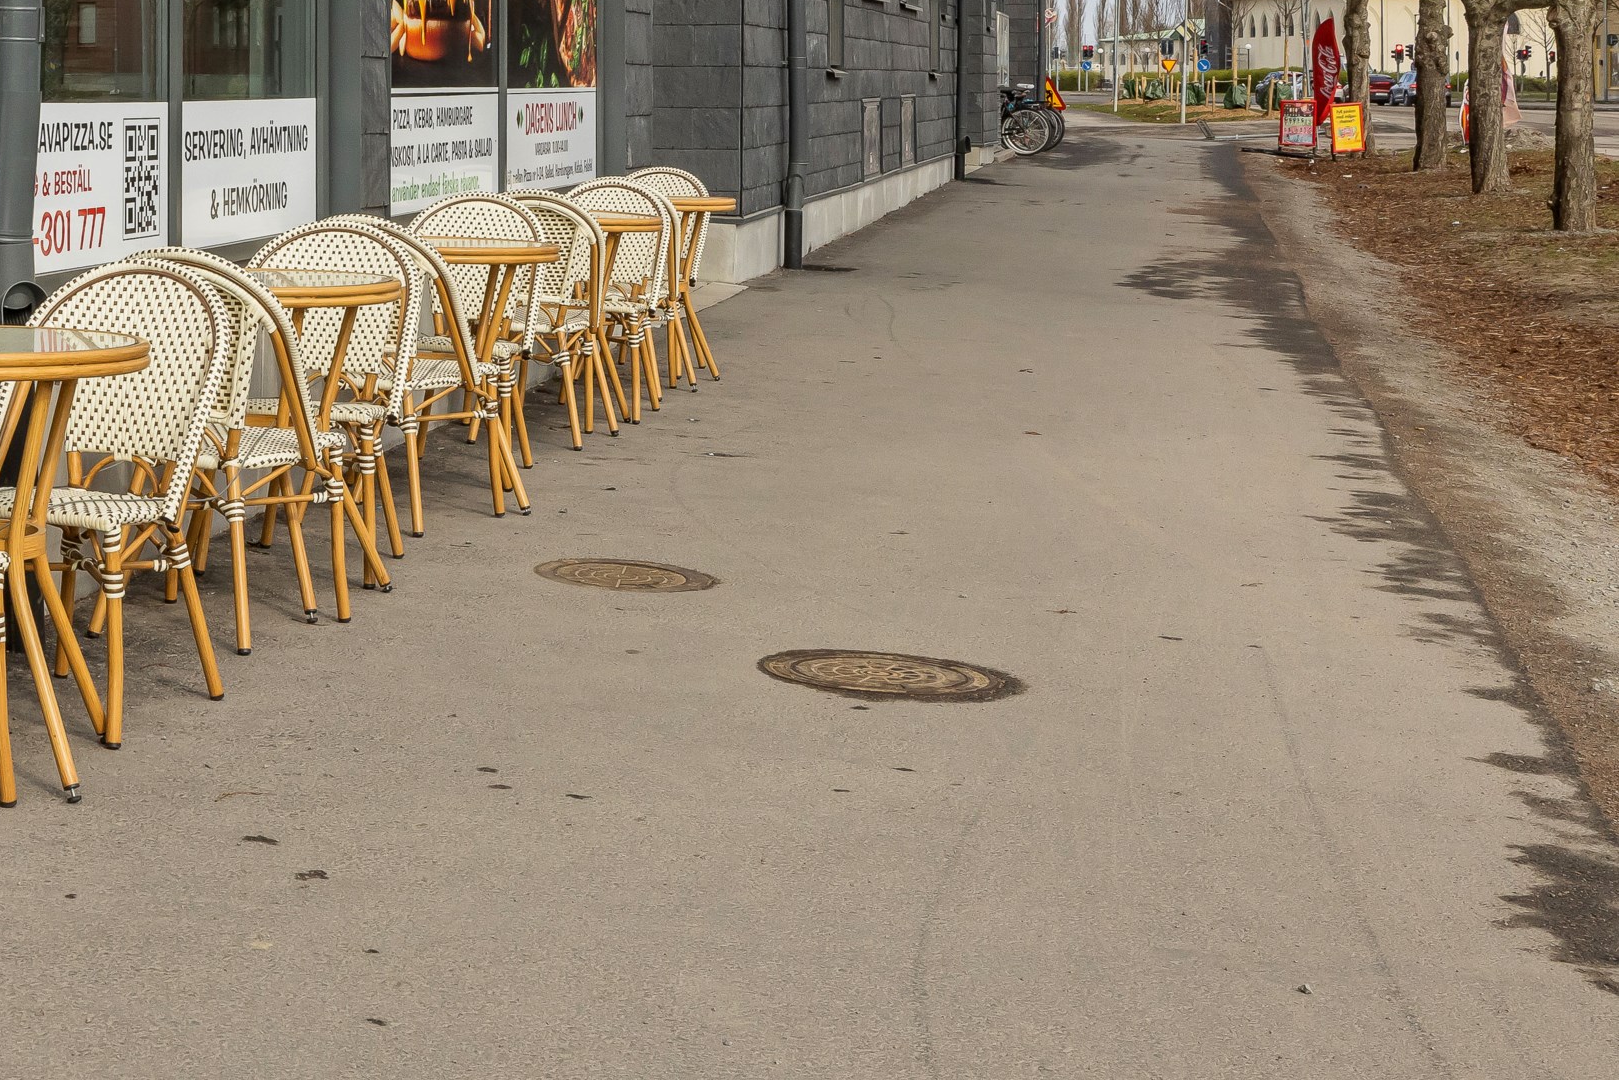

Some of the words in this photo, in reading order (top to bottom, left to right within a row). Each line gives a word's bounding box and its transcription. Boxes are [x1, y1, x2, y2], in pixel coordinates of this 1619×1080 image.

[393, 108, 413, 132] PIZZA,
[414, 108, 435, 130] KEBAB,
[525, 102, 554, 136] DAGENS
[556, 101, 577, 132] LUNCH
[37, 121, 113, 153] AVAPIZZA.SE
[184, 128, 247, 162] SERVERING,
[250, 120, 308, 156] AVHÄMTNING
[42, 171, 51, 197] &
[54, 164, 92, 195] BESTÄLL
[210, 188, 219, 220] &
[223, 178, 288, 217] HEMKÖRNING
[78, 207, 105, 250] 777
